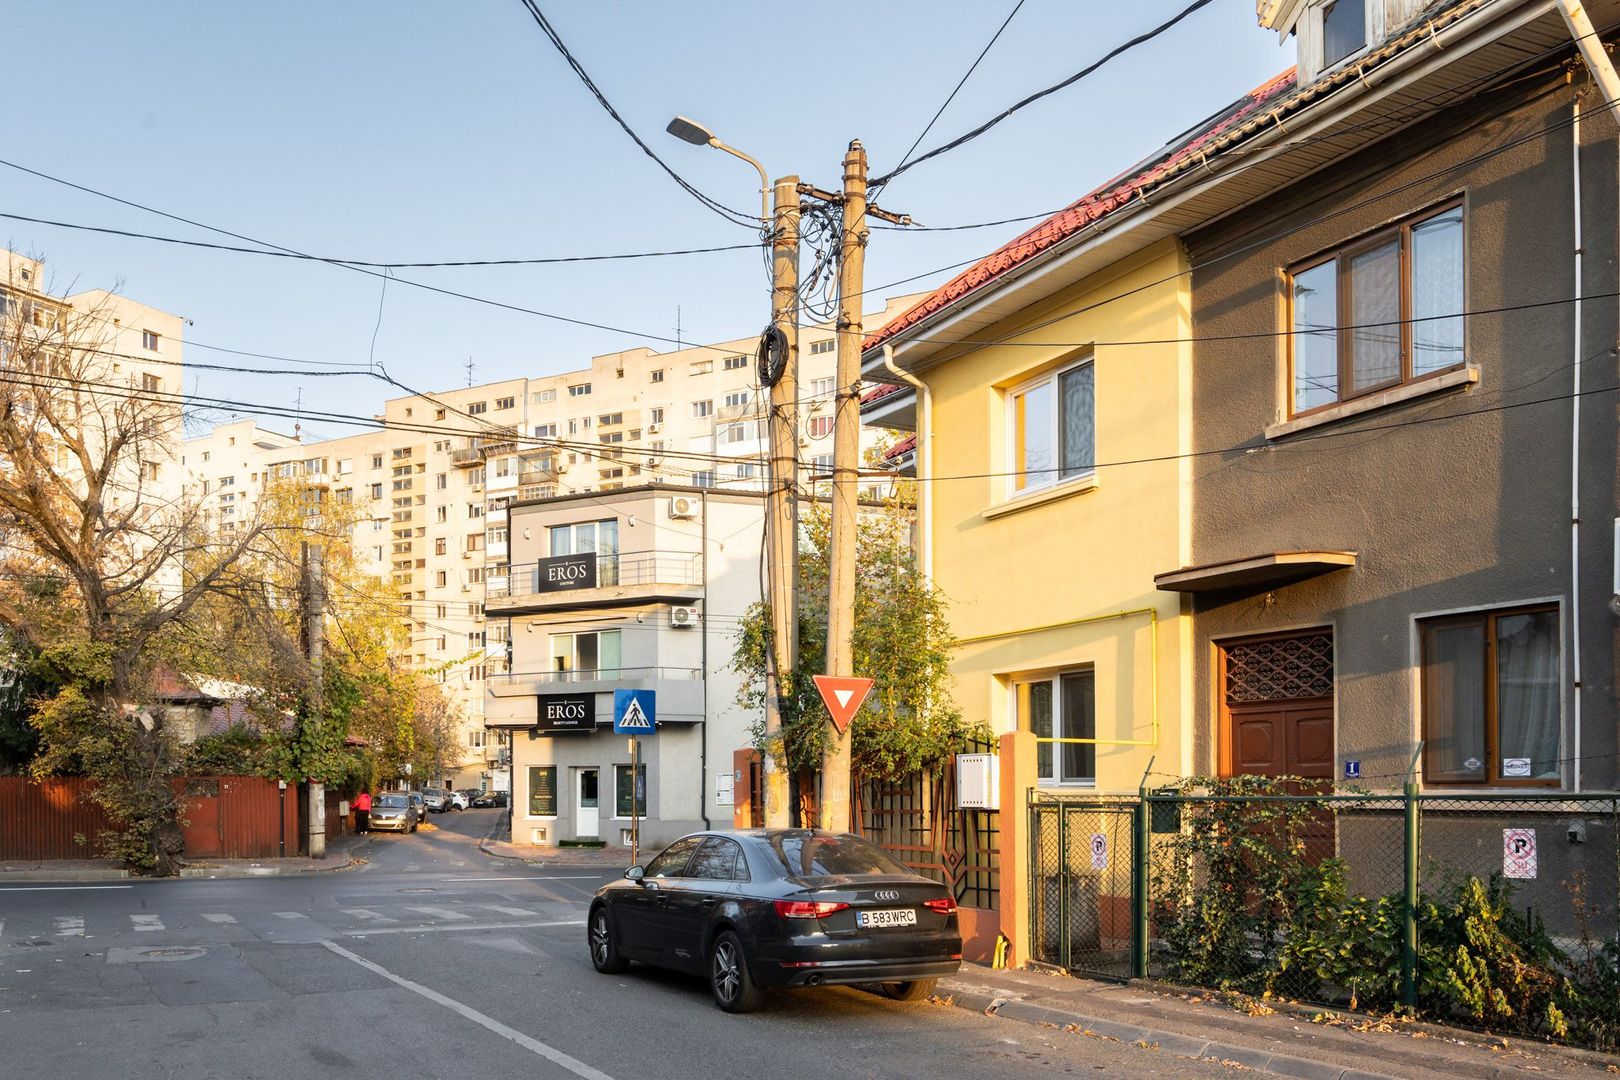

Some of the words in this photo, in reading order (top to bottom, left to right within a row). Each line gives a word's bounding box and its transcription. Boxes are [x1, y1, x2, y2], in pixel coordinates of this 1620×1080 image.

[548, 564, 586, 581] EROS
[547, 704, 585, 719] EROS
[1350, 762, 1355, 773] 1
